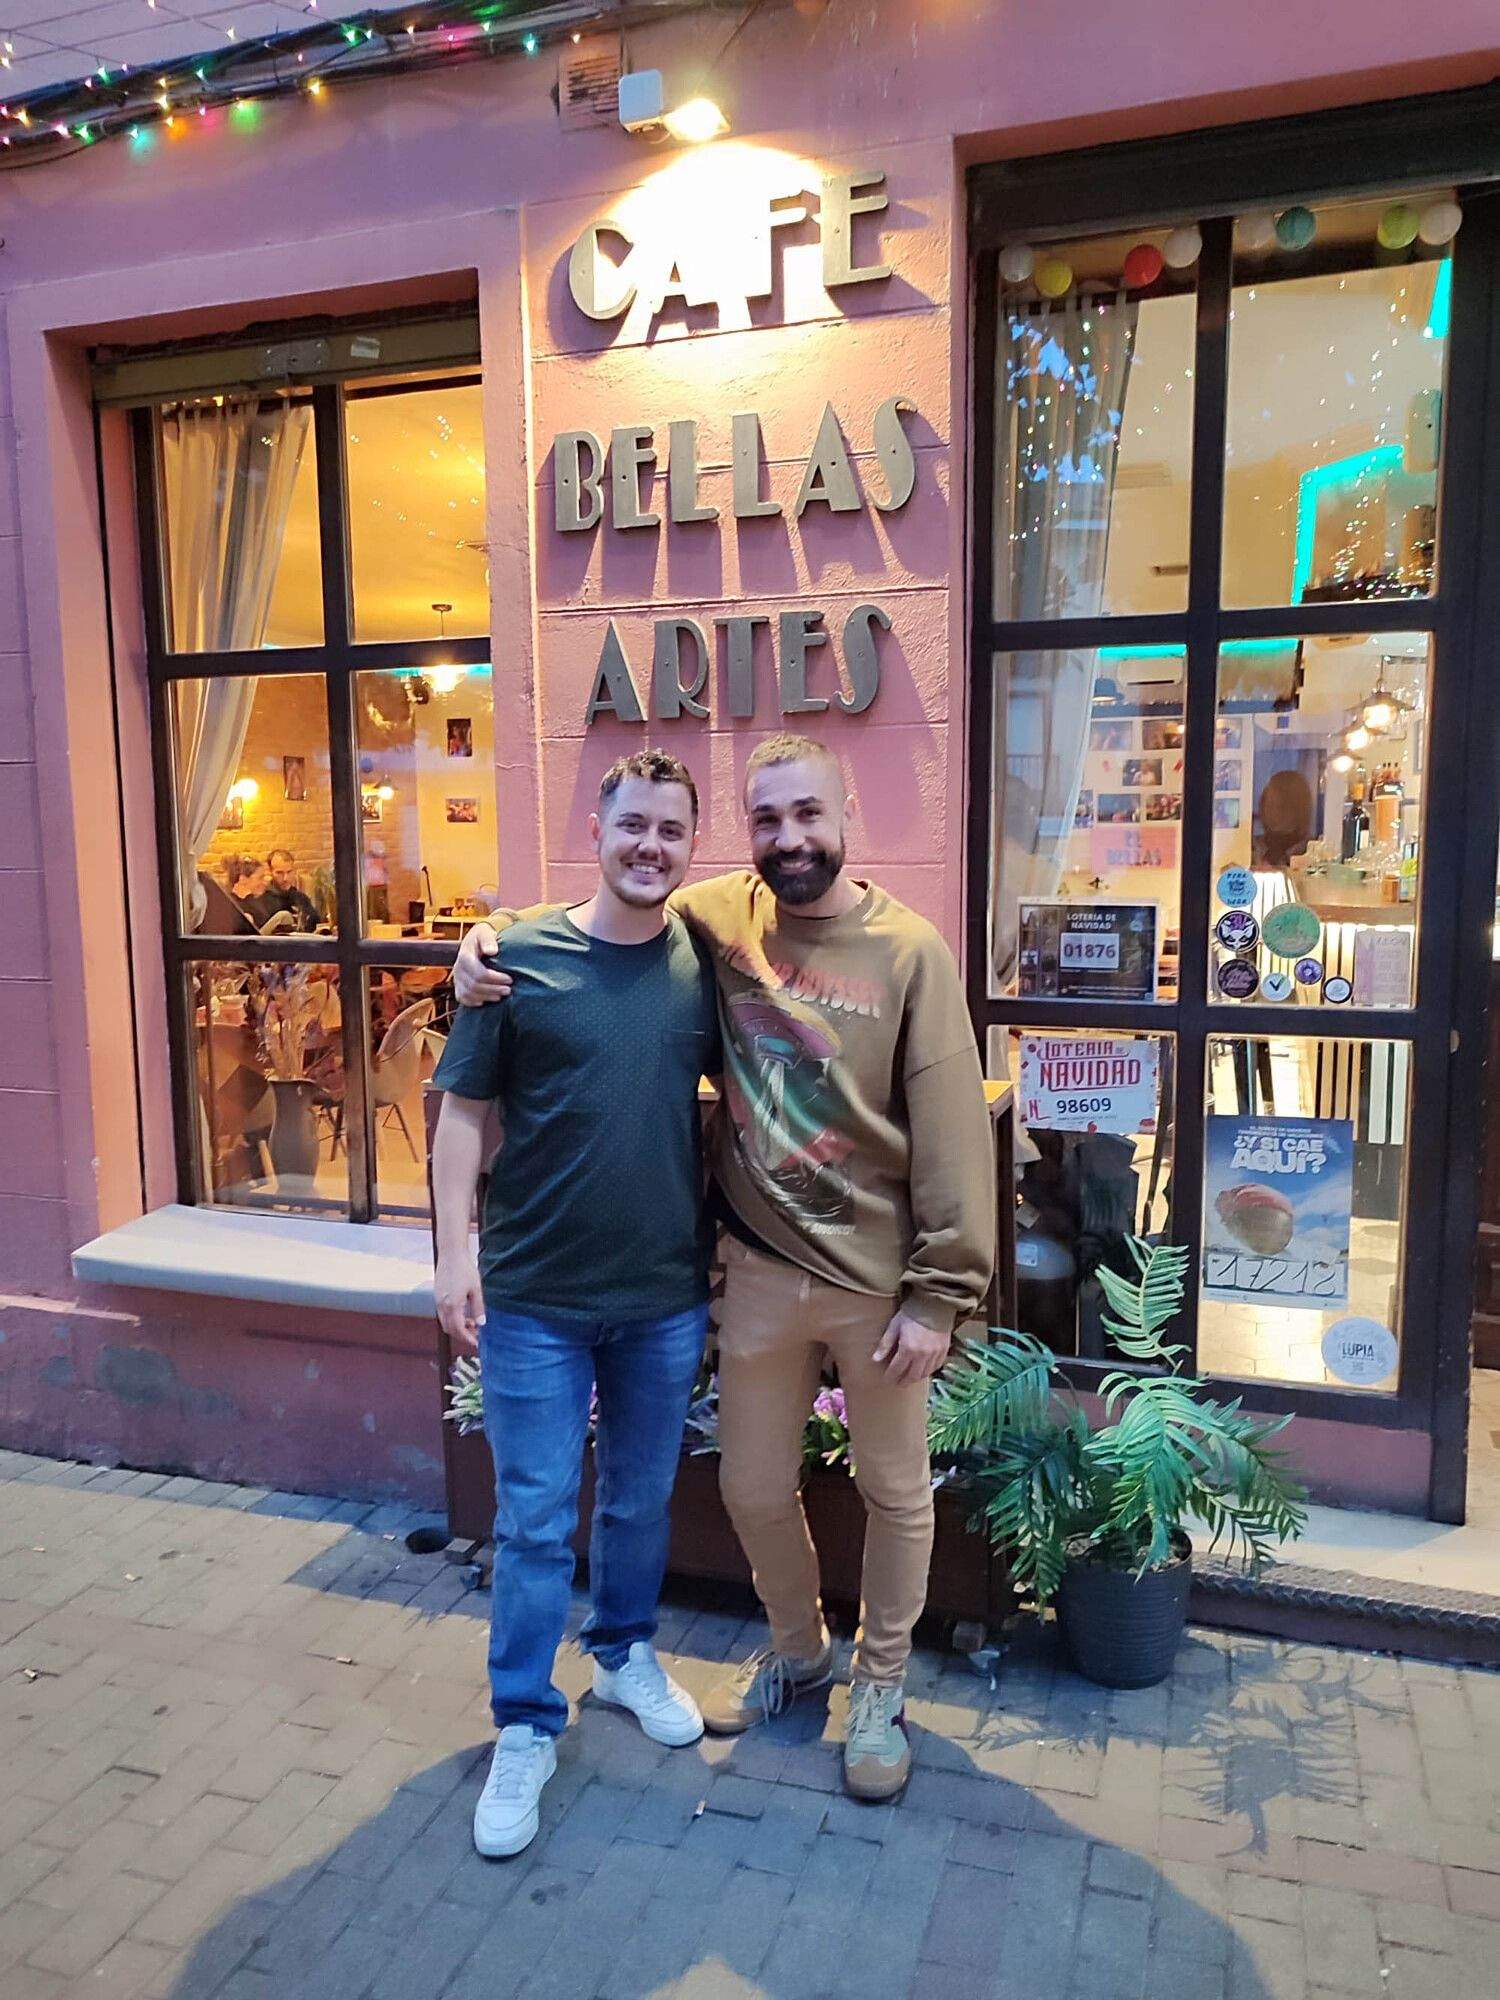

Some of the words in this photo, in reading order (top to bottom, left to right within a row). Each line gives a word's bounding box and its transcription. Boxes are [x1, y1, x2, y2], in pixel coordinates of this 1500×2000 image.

[554, 396, 917, 532] BELLAS
[585, 604, 891, 725] ARTES
[1071, 921, 1112, 930] NAVIDAD
[1063, 943, 1116, 959] 01876
[1040, 1059, 1141, 1090] NAVIDAD
[1056, 1097, 1112, 1114] 98609
[1259, 1136, 1280, 1151] SI
[1281, 1138, 1324, 1153] CAE
